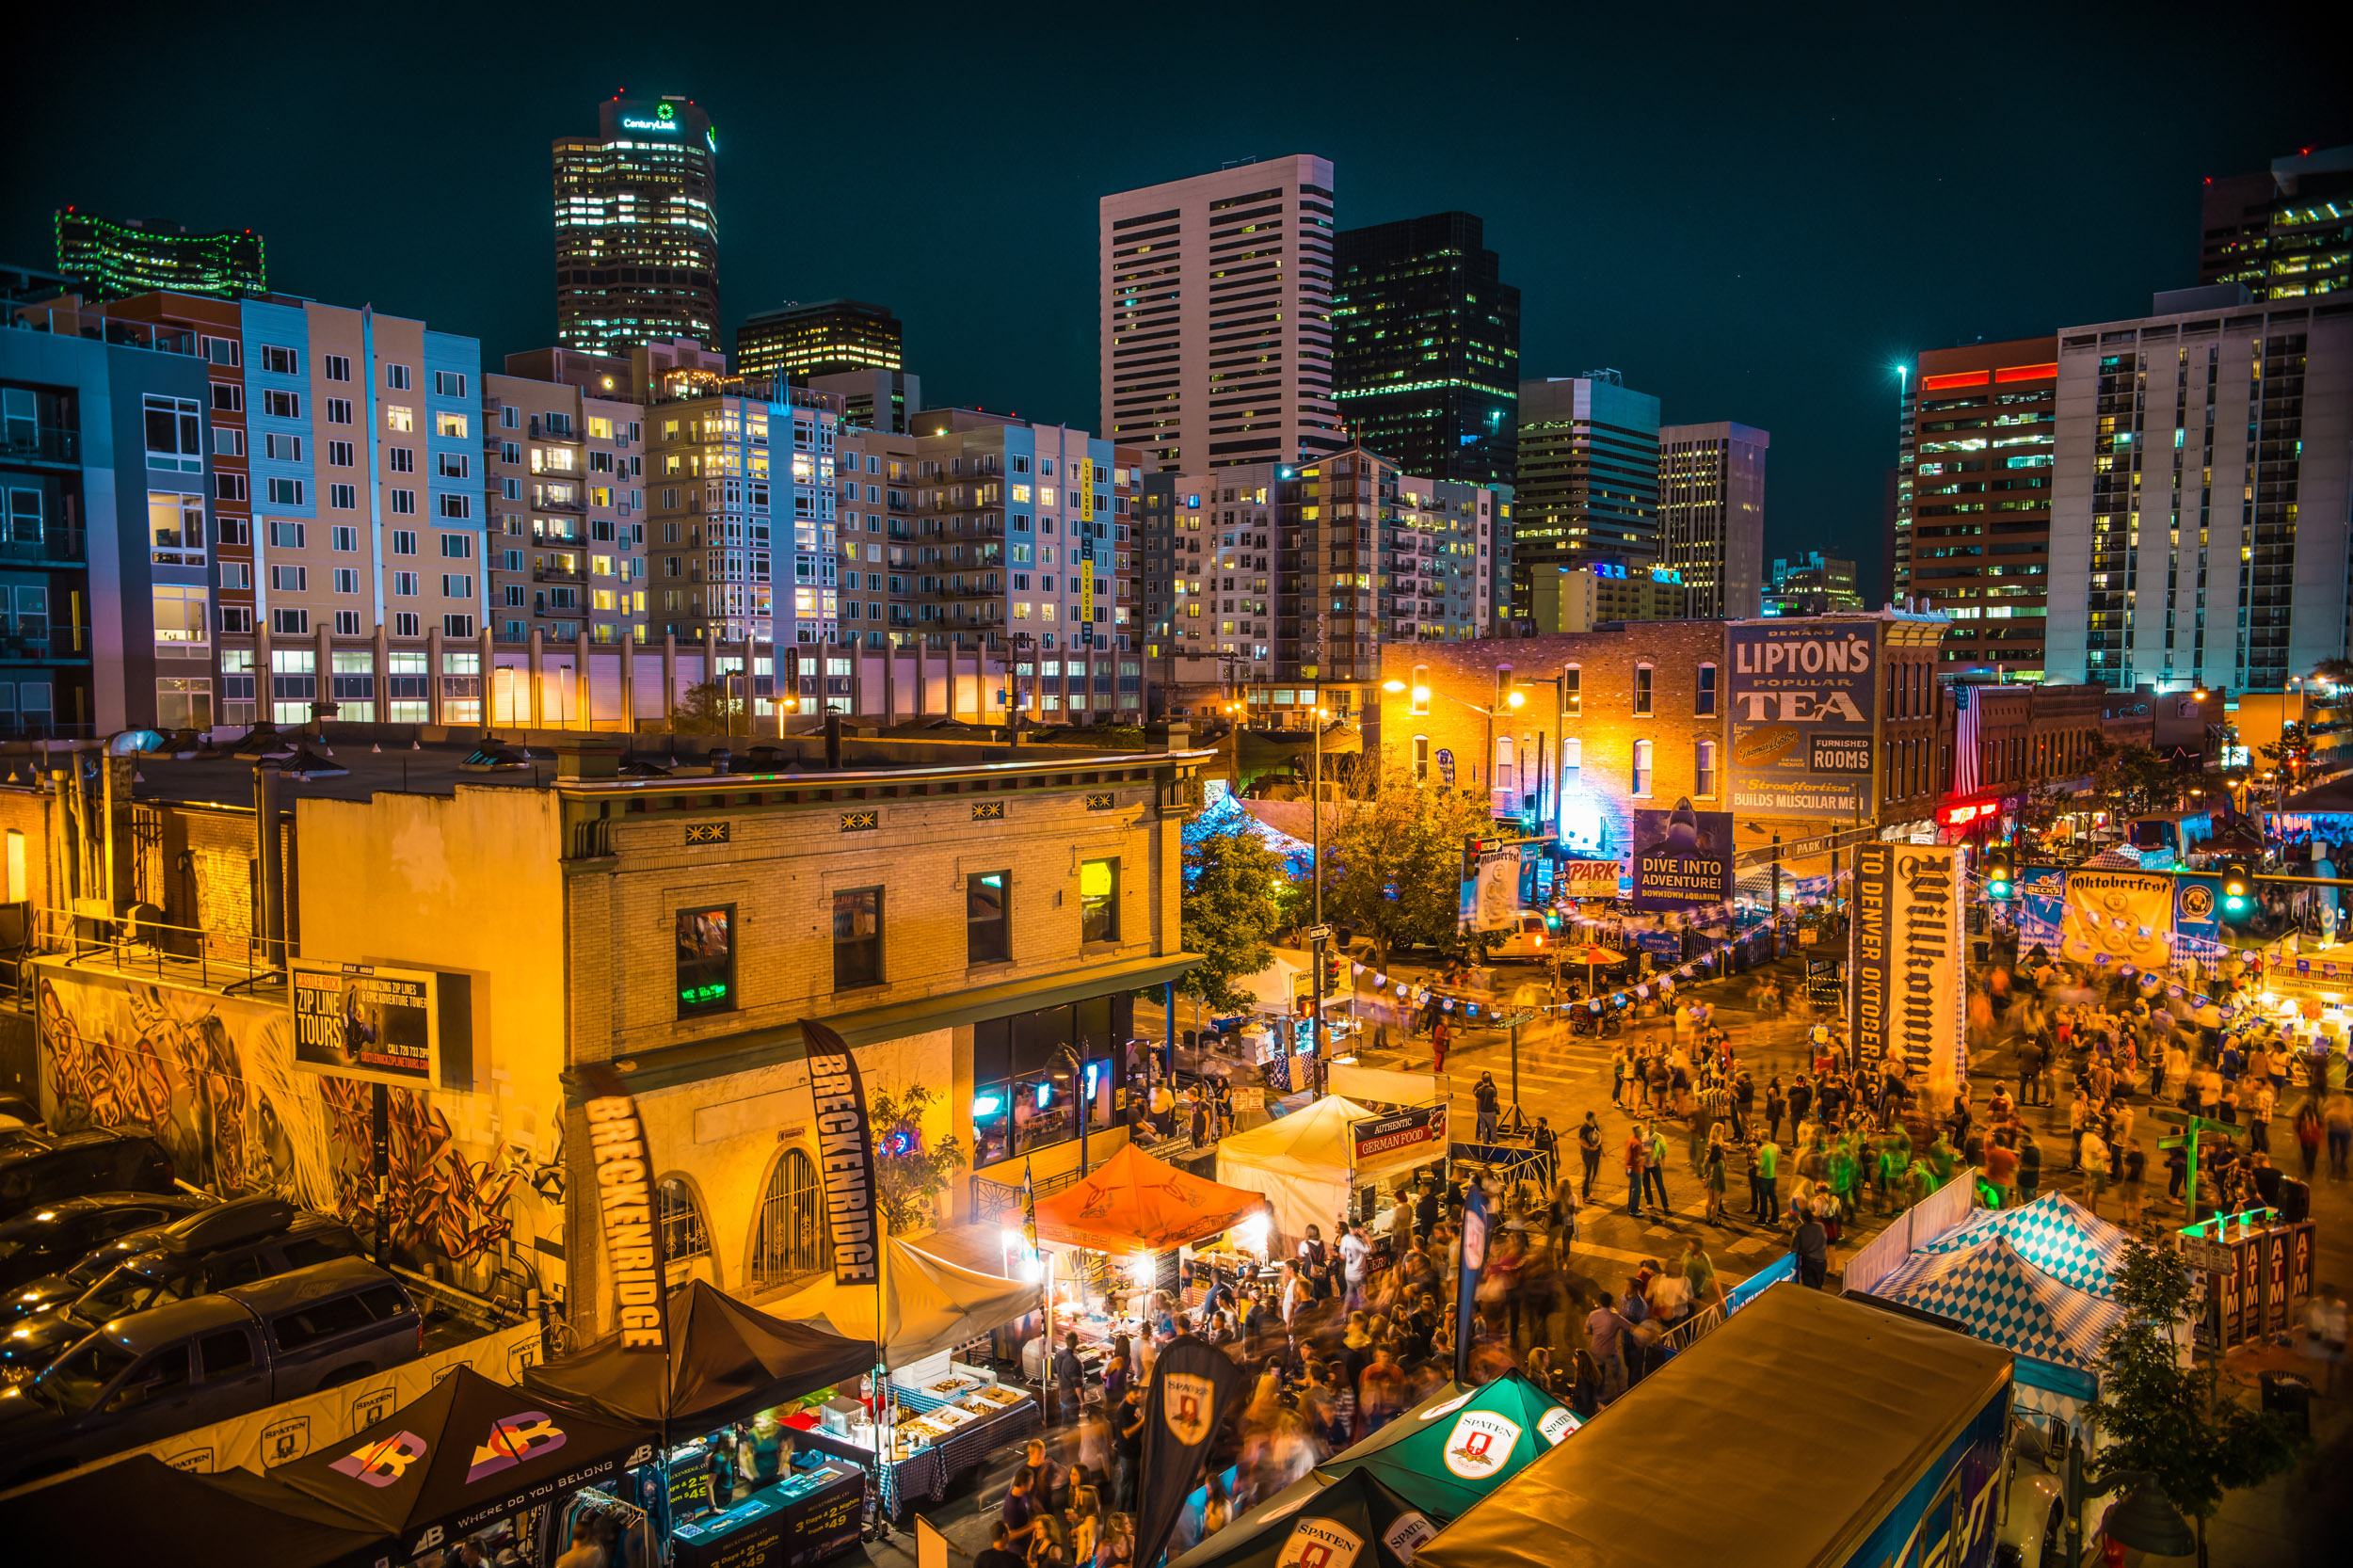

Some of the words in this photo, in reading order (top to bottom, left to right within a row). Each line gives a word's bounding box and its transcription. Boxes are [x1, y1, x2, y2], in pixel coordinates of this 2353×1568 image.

[624, 119, 675, 130] CenturyLink
[1736, 632, 1869, 674] LIPTON'S
[1736, 691, 1867, 722] TEA
[1816, 739, 1868, 748] FURNISHED
[1814, 751, 1869, 769] ROOMS
[1776, 794, 1836, 809] MUSCULAR
[1796, 840, 1821, 854] PARK
[1570, 863, 1618, 881] PARK
[1643, 858, 1678, 874] DIVE
[1683, 860, 1722, 875] INTO
[1861, 850, 1885, 874] TO
[1642, 875, 1721, 889] ADVENTURE!
[2027, 886, 2061, 894] BECK'S
[2071, 875, 2168, 893] Oktoberfest
[1642, 889, 1684, 899] DOWNTOWN
[1685, 891, 1721, 902] AQUARIUM
[1861, 883, 1883, 960] DENVER
[296, 973, 321, 988] CASTLE
[322, 977, 339, 990] ROCK
[368, 980, 391, 992] AMAZING
[392, 982, 401, 993] ZIP
[402, 983, 416, 995] LINES
[297, 989, 314, 1013] ZIP
[316, 991, 340, 1016] LINE
[367, 993, 378, 1003] EPIC
[379, 994, 409, 1007] ADVENTURE
[298, 1014, 342, 1048] TOURS
[1860, 966, 1882, 1099] OKTOBERFES
[387, 1043, 399, 1054] CALL
[400, 1045, 409, 1056] 720
[409, 1046, 418, 1057] 733
[1375, 1117, 1412, 1134] AUTHENTIC
[1362, 1135, 1400, 1155] GERMAN
[1401, 1129, 1423, 1144] FOOD
[807, 1053, 876, 1286] BRECKENRIDGE
[584, 1095, 663, 1349] BRECKENRIDGE
[2270, 1238, 2284, 1305] ATM
[2294, 1232, 2308, 1295] ATM
[2227, 1251, 2239, 1316] ATM
[2246, 1243, 2258, 1307] ATM
[511, 1340, 541, 1356] SPATEN
[356, 1393, 393, 1410] SPATEN
[265, 1421, 306, 1439] SPATEN
[1462, 1417, 1514, 1439] SPATEN
[1545, 1413, 1572, 1437] SPATEN
[688, 1477, 697, 1489] 2
[458, 1504, 504, 1528] WHERE
[508, 1495, 525, 1510] DO
[529, 1483, 553, 1501] YOU
[558, 1461, 613, 1487] BELONG
[795, 1521, 804, 1533] 3
[805, 1515, 822, 1525] Days
[829, 1507, 837, 1518] 2
[839, 1498, 860, 1510] Nights
[808, 1525, 823, 1535] from
[825, 1515, 846, 1528] $49
[1297, 1524, 1355, 1553] SPATEN
[1390, 1518, 1427, 1550] SPATEN
[721, 1552, 738, 1564] Days
[747, 1545, 755, 1557] 2
[757, 1535, 779, 1548] Nights
[741, 1553, 765, 1568] $49
